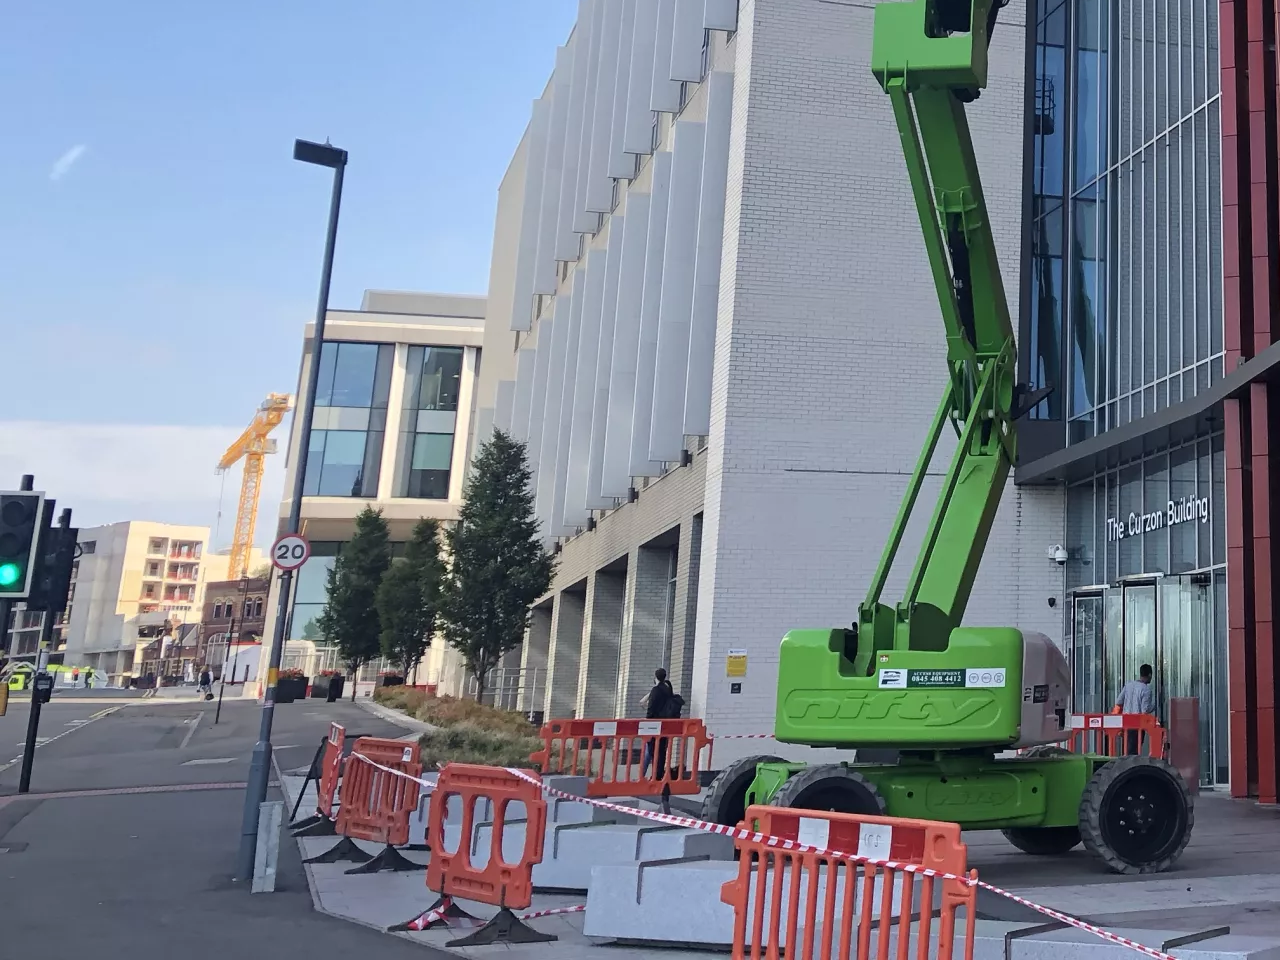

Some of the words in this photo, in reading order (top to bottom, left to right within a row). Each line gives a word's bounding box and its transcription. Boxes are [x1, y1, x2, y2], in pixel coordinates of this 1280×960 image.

[1107, 517, 1124, 541] The
[1128, 510, 1163, 536] Curzon
[1167, 494, 1208, 525] Building
[277, 544, 305, 559] 20
[788, 691, 996, 727] nifty
